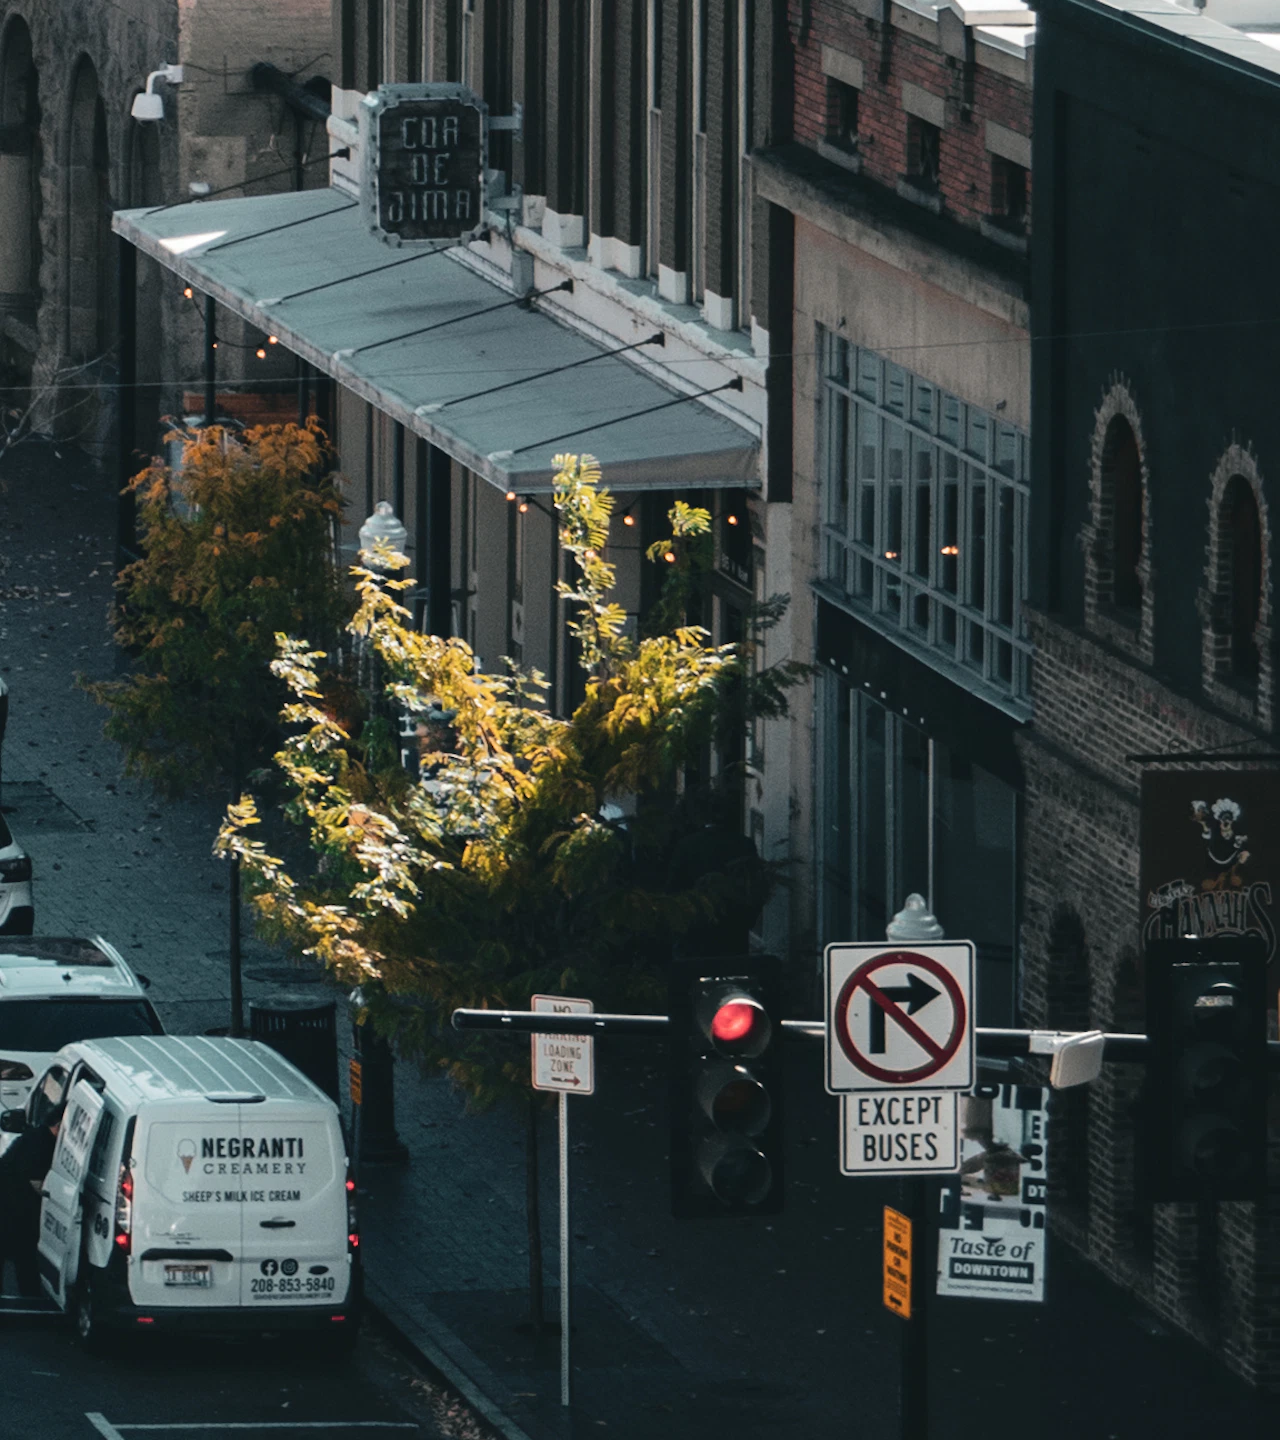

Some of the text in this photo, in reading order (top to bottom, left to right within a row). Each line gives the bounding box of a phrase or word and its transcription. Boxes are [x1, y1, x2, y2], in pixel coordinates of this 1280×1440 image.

[402, 116, 458, 149] COA
[412, 152, 450, 185] DE
[388, 190, 470, 222] JIMA
[543, 1044, 582, 1060] LOADING
[550, 1060, 574, 1074] ZONE
[858, 1096, 942, 1126] EXCEPT
[201, 1138, 304, 1159] NEGRANTI
[863, 1132, 939, 1162] BUSES
[203, 1163, 307, 1175] CREAMERY
[182, 1190, 301, 1202] SHEEP'S MILK ICE CREAM
[950, 1237, 1035, 1261] Taste of
[953, 1262, 1029, 1279] DOWNTOWN
[250, 1277, 335, 1293] 208-853-5840
